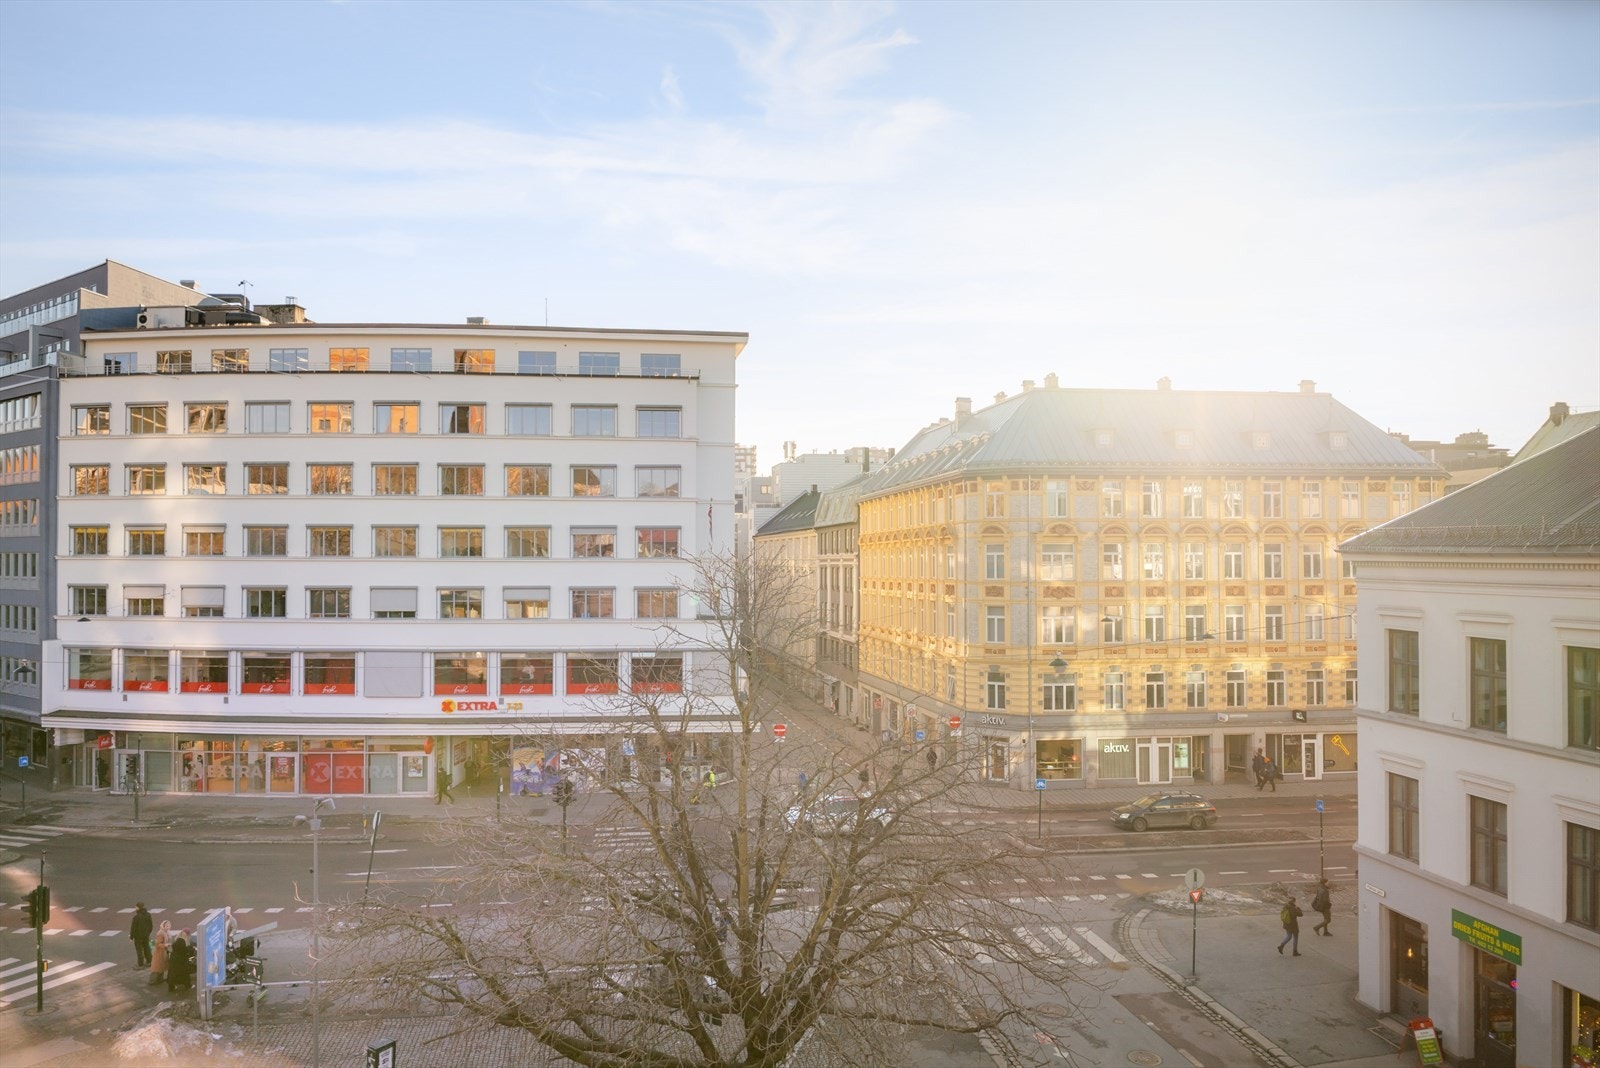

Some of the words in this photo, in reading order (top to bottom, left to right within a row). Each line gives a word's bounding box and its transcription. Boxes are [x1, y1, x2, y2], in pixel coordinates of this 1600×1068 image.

[457, 701, 497, 711] EXTRA
[1473, 920, 1499, 937] AFGHAN
[1453, 920, 1471, 935] DRIED
[1472, 929, 1495, 945] FRUITS
[1502, 941, 1520, 956] NUTS
